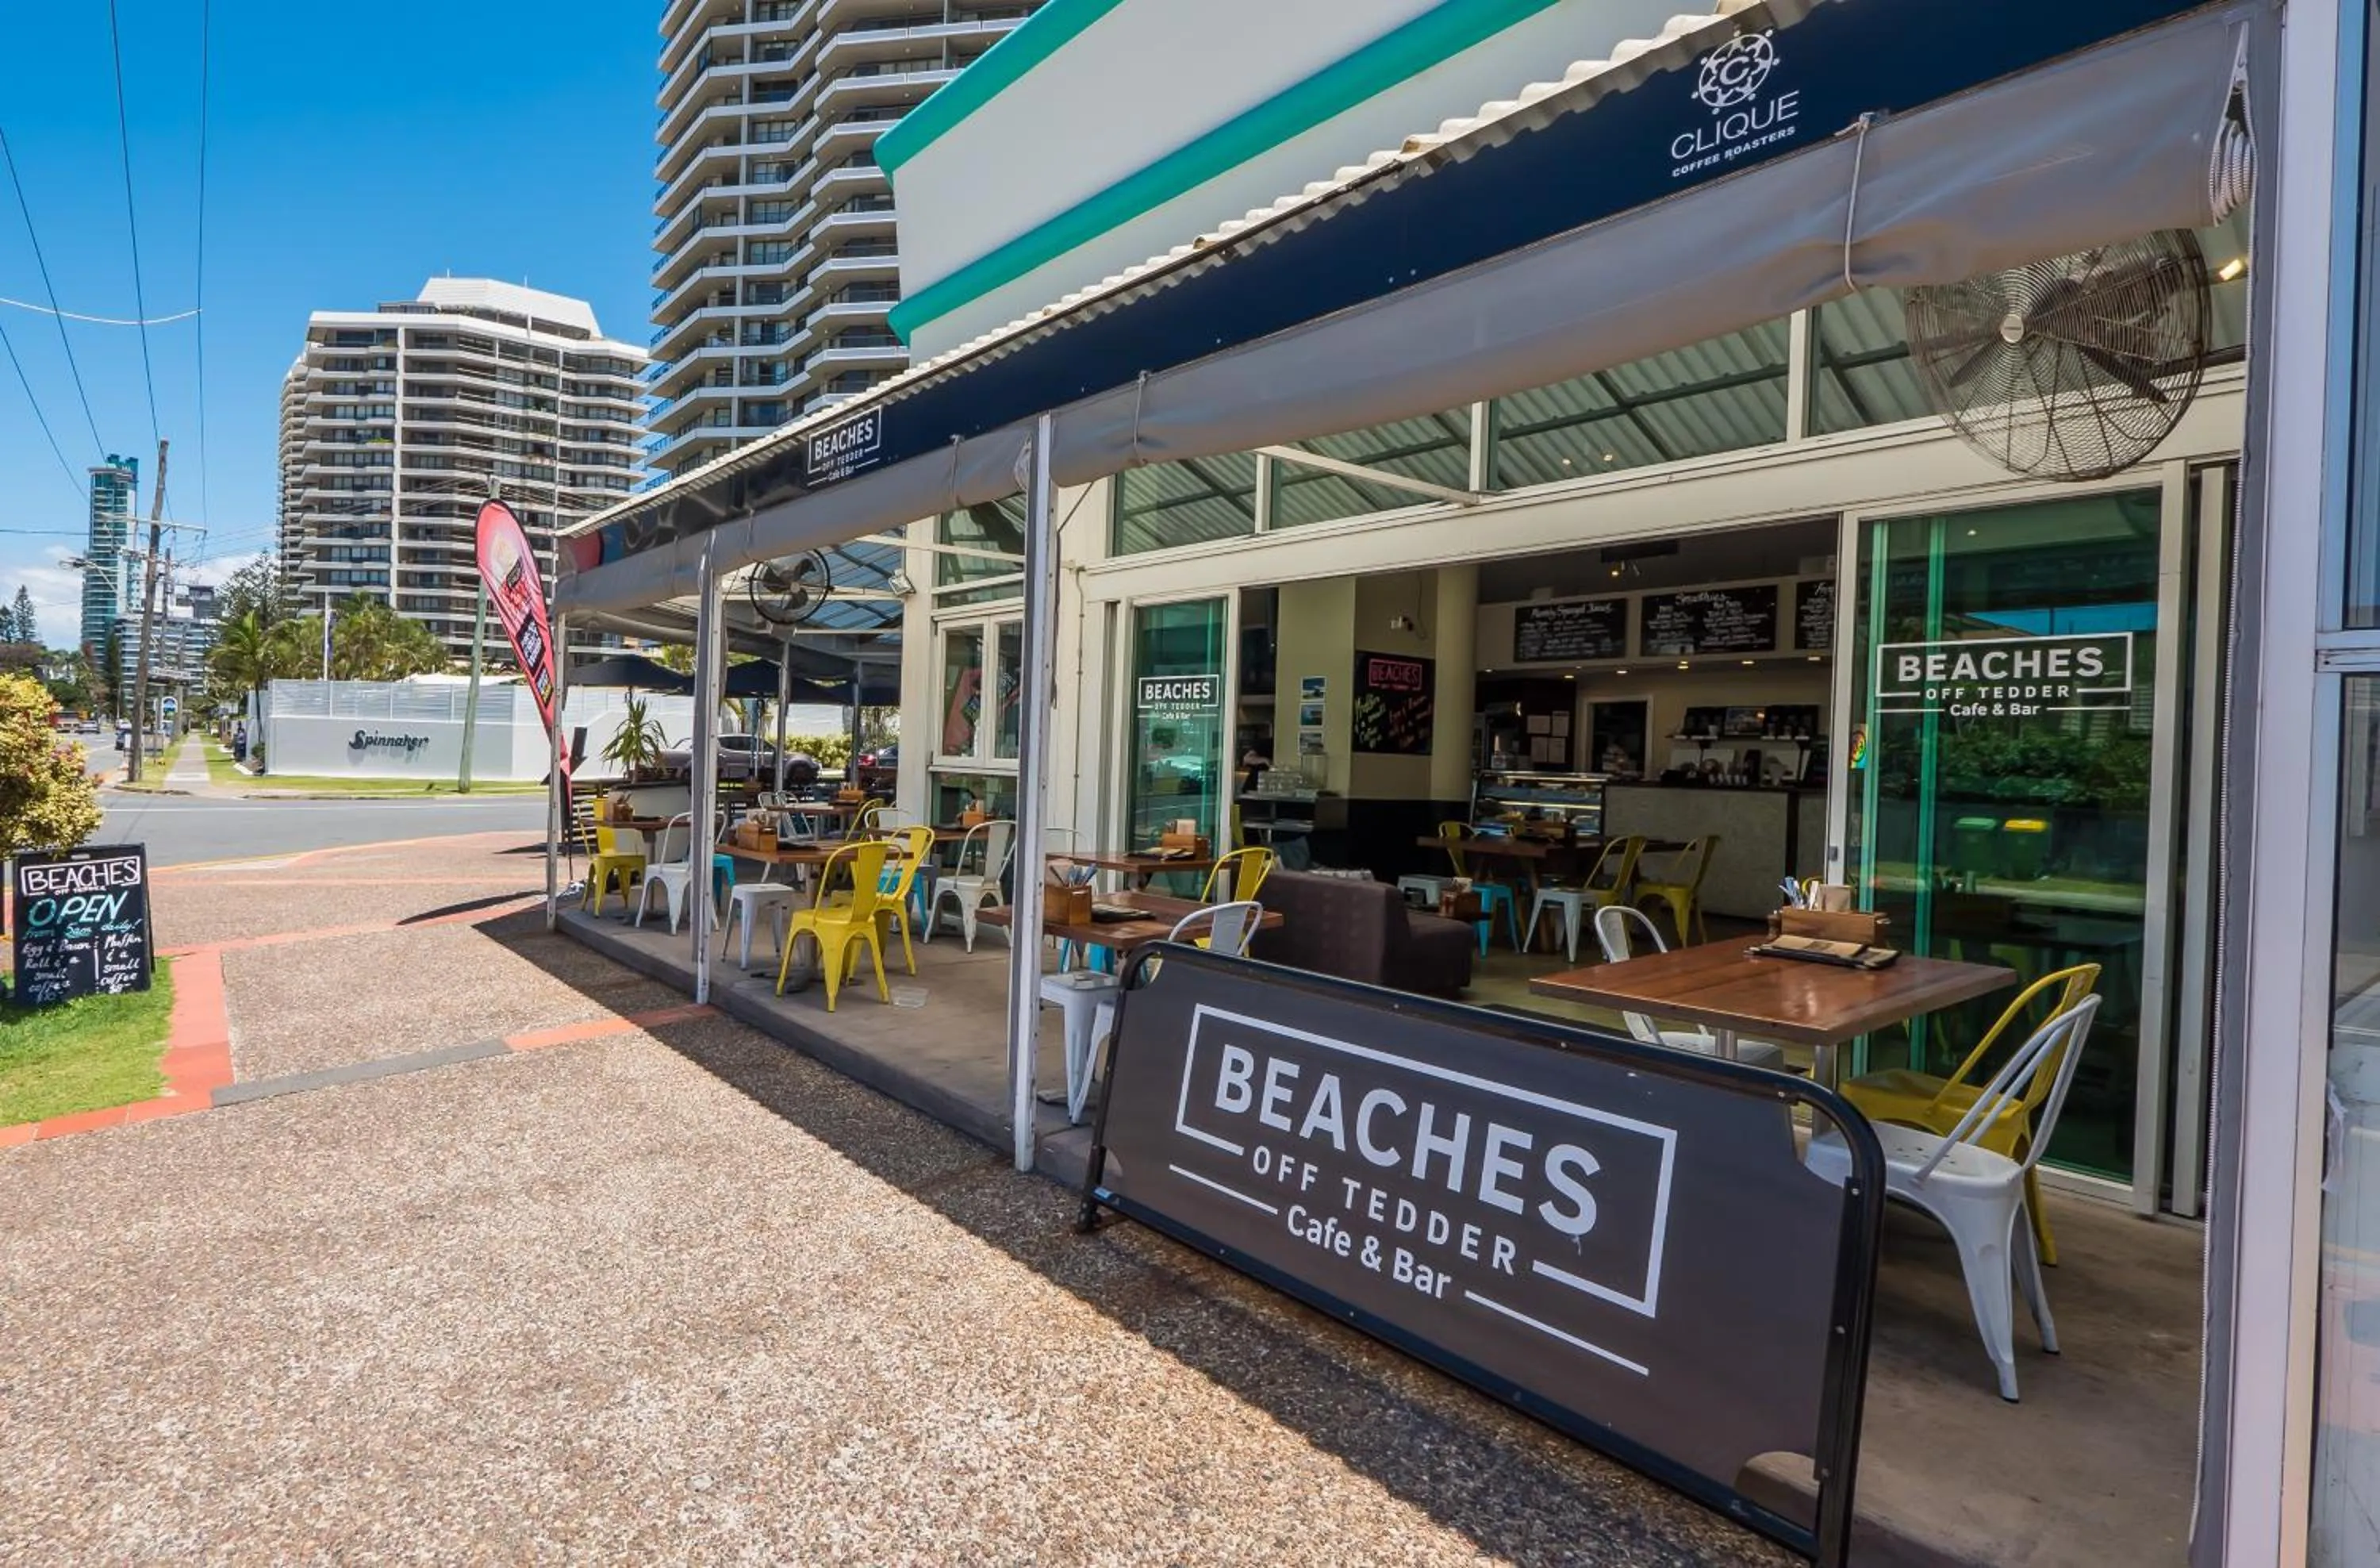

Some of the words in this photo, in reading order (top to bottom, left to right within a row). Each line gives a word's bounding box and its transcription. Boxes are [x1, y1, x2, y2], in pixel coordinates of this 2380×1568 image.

[1672, 90, 1800, 159] CLIQUE
[1672, 153, 1721, 177] COFFEE
[1724, 125, 1796, 159] ROASTERS
[815, 418, 873, 460] BEACHES
[1898, 647, 2104, 682] BEACHES
[1145, 682, 1211, 700] BEACHES
[1925, 688, 1965, 700] OFF
[1978, 685, 2070, 699] TEDDER
[1950, 703, 1987, 717] Cafe
[1992, 703, 2006, 716] &
[2010, 703, 2040, 716] Bar
[349, 729, 429, 751] Spinnaker
[28, 860, 137, 891] BEACHES
[29, 890, 129, 927] OPEN
[104, 933, 143, 950] Muffin
[101, 973, 138, 986] coffee
[103, 958, 140, 974] small
[1215, 1043, 1601, 1236] BEACHES
[1252, 1144, 1319, 1191] OFF
[1342, 1178, 1518, 1276] TEDDER
[1287, 1205, 1351, 1256] Cafe
[1360, 1235, 1382, 1271] &
[1392, 1247, 1452, 1298] Bar
